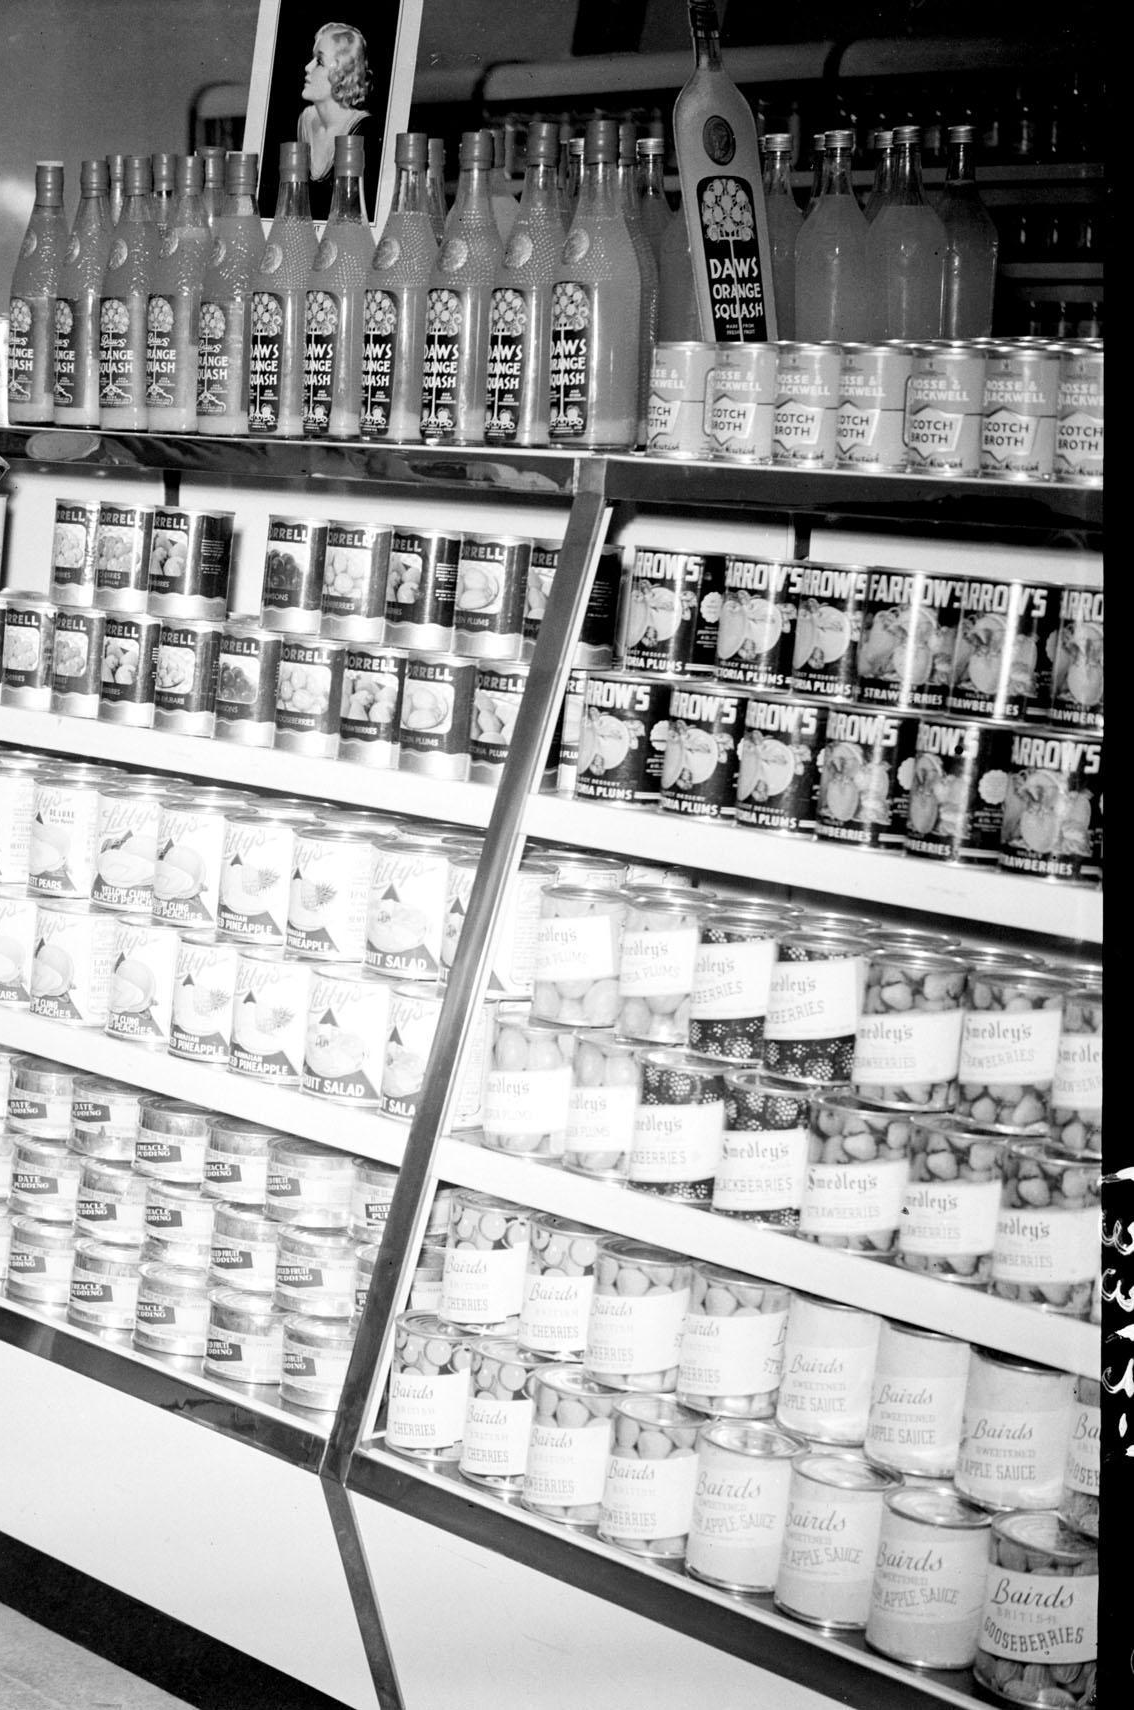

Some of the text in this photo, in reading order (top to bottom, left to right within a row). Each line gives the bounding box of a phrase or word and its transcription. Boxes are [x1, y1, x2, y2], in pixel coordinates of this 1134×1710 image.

[709, 256, 759, 280] DAWS
[713, 283, 762, 299] ORANGE
[714, 302, 763, 320] SQUASH
[870, 573, 965, 609] FARROW'S
[647, 659, 683, 672] PLUMS
[747, 671, 783, 685] PLUMS
[814, 681, 852, 695] PLUMS
[597, 785, 632, 800] PLUMS
[680, 800, 718, 816] PLUMS
[759, 813, 797, 829] PLUMS
[38, 878, 62, 890] PEARS
[225, 920, 272, 934] PINEAPPLE
[385, 956, 427, 971] SALAD
[178, 1041, 225, 1056] PINEAPPLE
[240, 1058, 288, 1075] PINEAPPLE
[324, 1079, 365, 1097] SALAD
[17, 1174, 41, 1183] DATE
[897, 1428, 937, 1446] SAUCE
[971, 1419, 1034, 1442] Bairds
[996, 1463, 1037, 1482] SAUCE
[876, 1541, 943, 1573] Bairds
[990, 1578, 1075, 1609] Bairds
[983, 1616, 1085, 1653] GOOSEBERRIES
